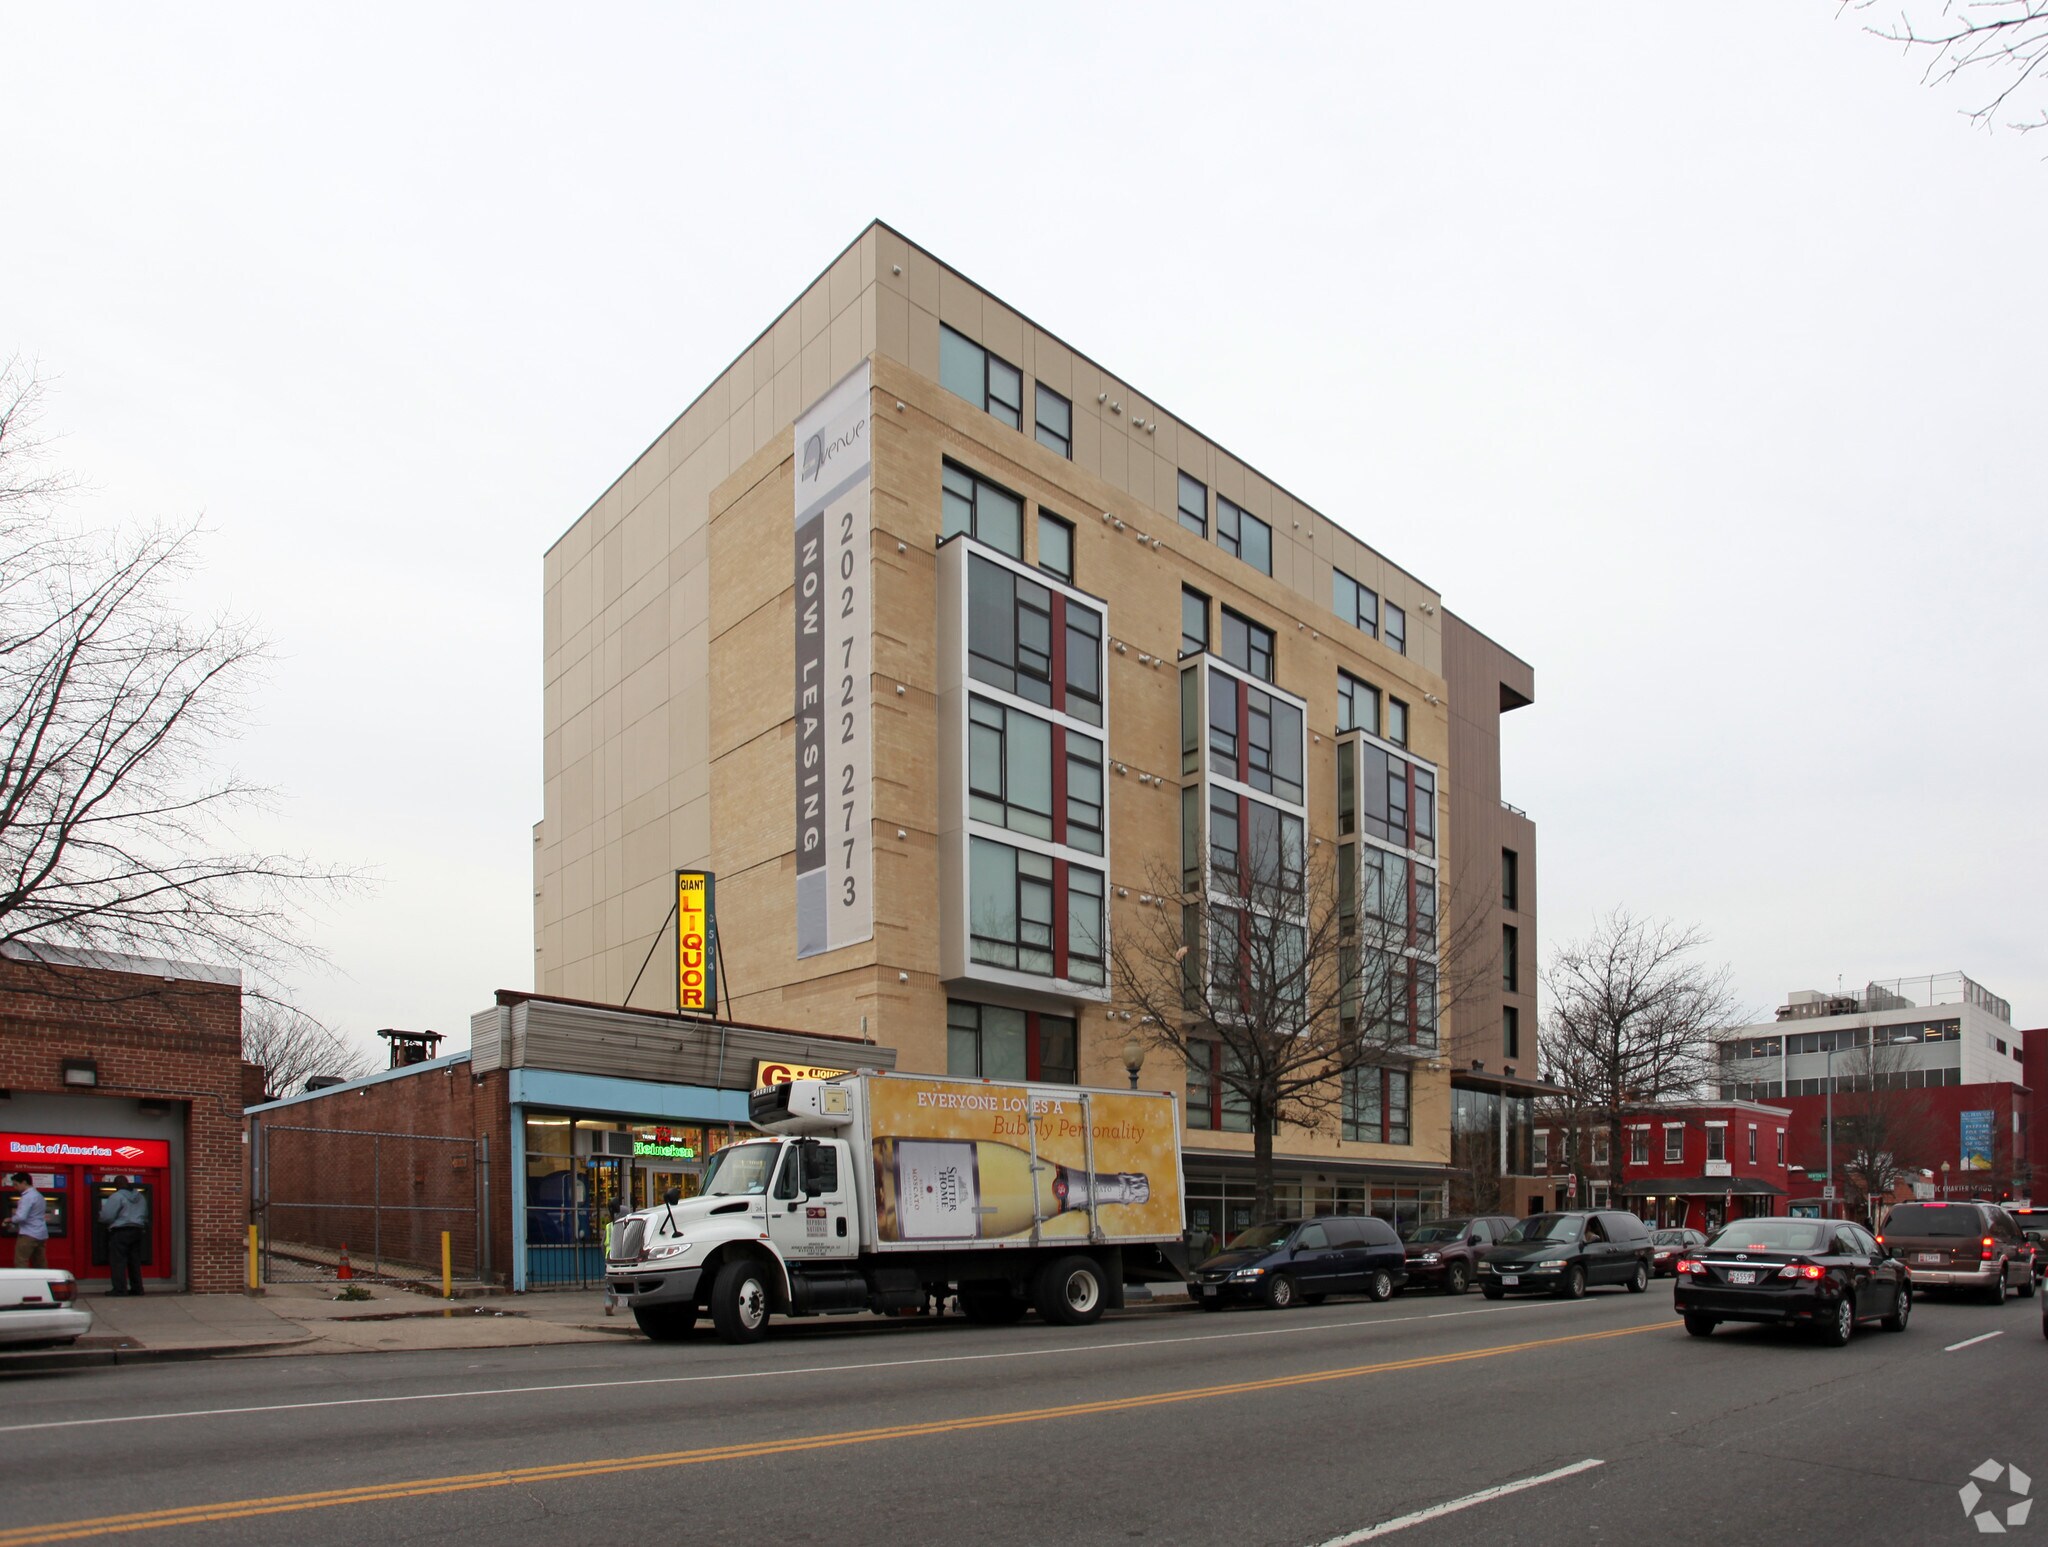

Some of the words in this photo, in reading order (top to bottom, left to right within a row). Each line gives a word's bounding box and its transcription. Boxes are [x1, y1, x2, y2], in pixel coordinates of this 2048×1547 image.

[803, 538, 818, 634] NOW
[841, 511, 854, 620] 202
[841, 636, 854, 745] 722
[803, 658, 819, 853] LEASING
[841, 764, 856, 907] 2773
[680, 880, 704, 891] GIANT
[682, 896, 703, 1005] LIQUOR
[753, 1086, 777, 1098] CARRIER
[917, 1091, 998, 1111] EVERYONE
[1053, 1100, 1064, 1115] A
[10, 1142, 45, 1153] Bank
[46, 1144, 59, 1154] of
[60, 1144, 112, 1156] America
[634, 1142, 694, 1158] Heineken
[1058, 1118, 1145, 1144] Peronality
[912, 1168, 920, 1211] MOSCATO
[939, 1171, 949, 1208] HOME
[946, 1166, 957, 1212] SUTTER
